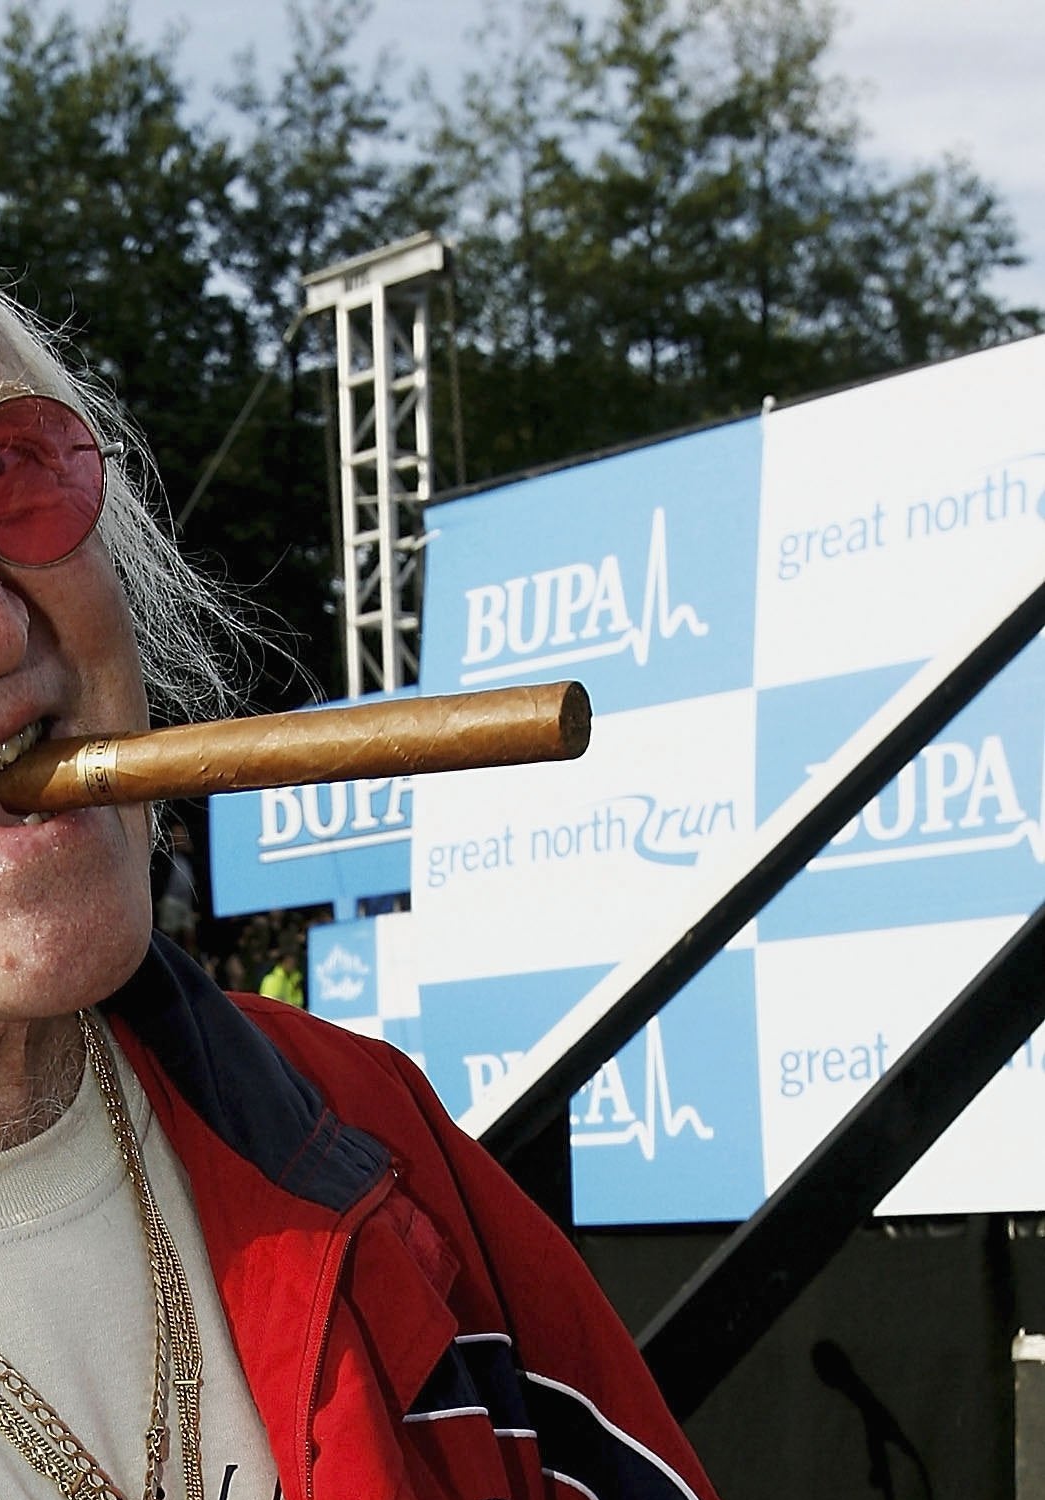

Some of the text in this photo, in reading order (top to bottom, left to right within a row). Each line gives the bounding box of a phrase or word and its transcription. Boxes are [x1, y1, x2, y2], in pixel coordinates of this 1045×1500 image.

[778, 470, 1027, 581] great north
[461, 554, 633, 666] BUPA
[427, 799, 737, 888] great north run
[780, 1033, 889, 1098] great
